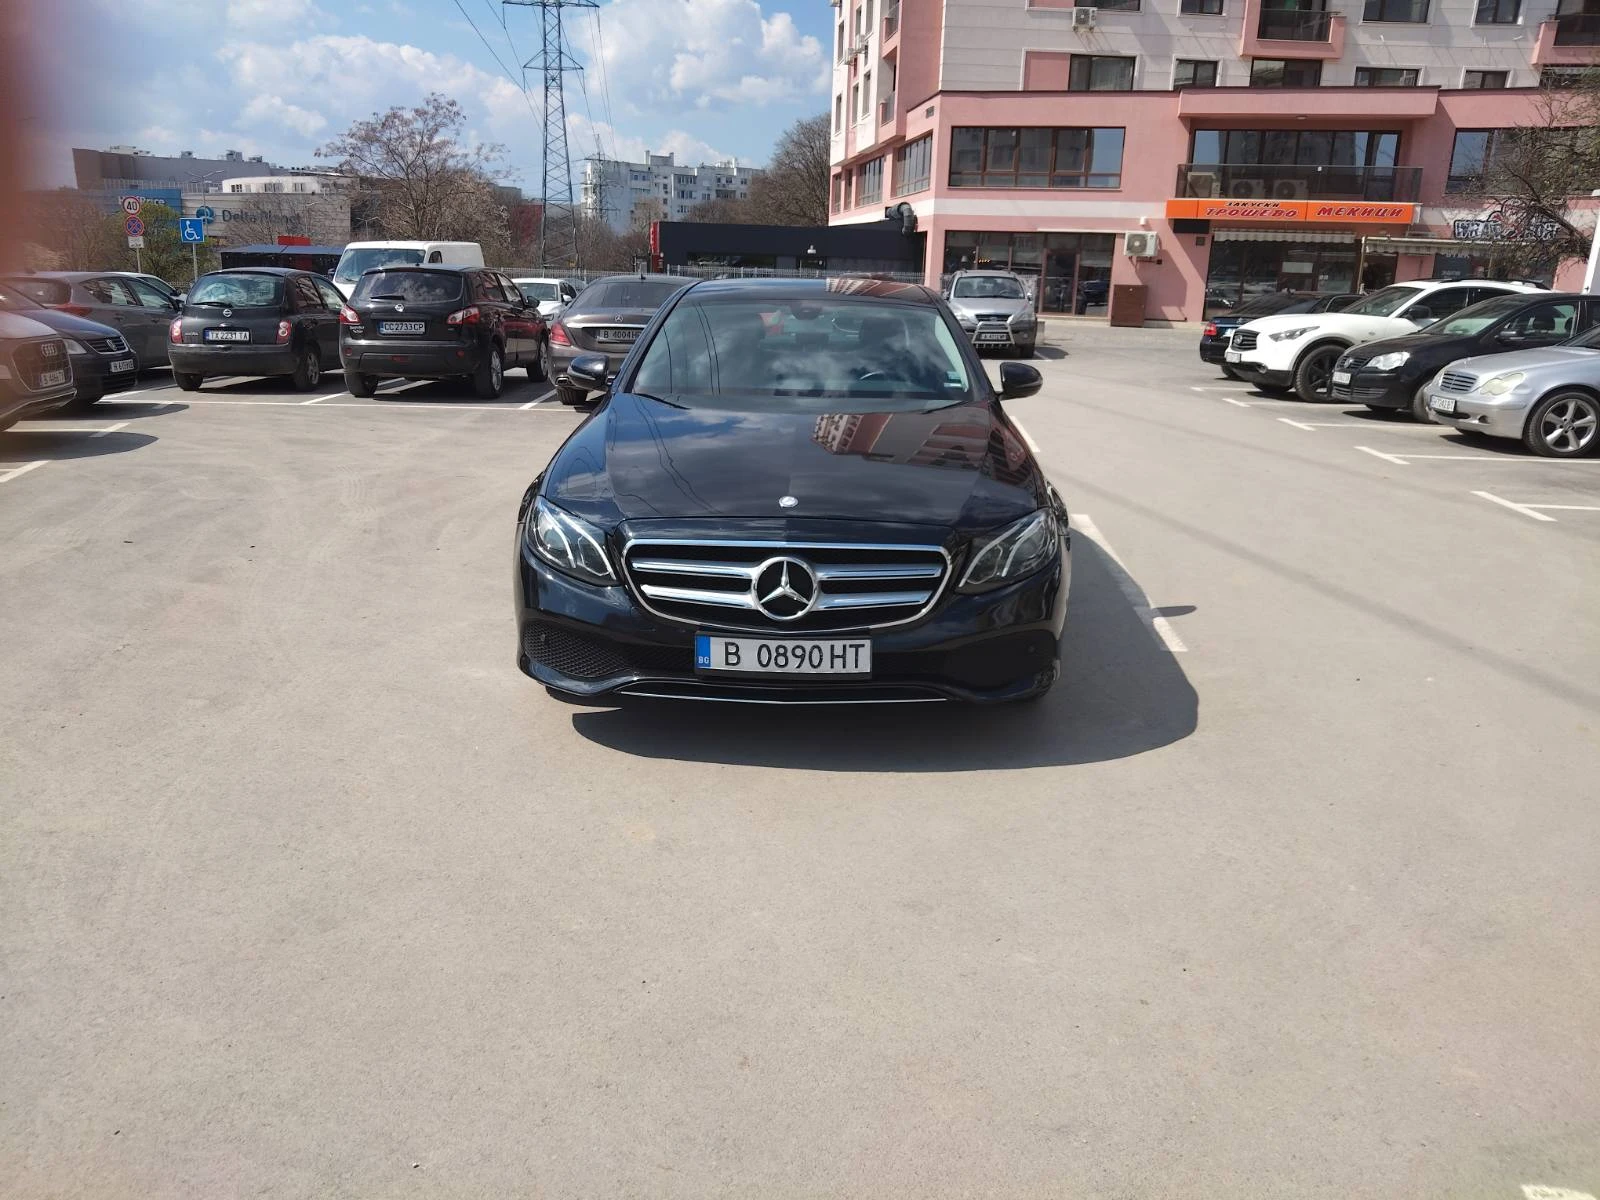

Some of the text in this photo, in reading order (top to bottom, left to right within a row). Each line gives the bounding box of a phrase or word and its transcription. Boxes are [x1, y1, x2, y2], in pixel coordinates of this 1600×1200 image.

[126, 201, 138, 210] 40
[221, 209, 257, 223] Delta
[1205, 206, 1404, 218] ТРОШЕВО МЕКИЦИ
[724, 641, 742, 667] B
[697, 656, 710, 665] BG
